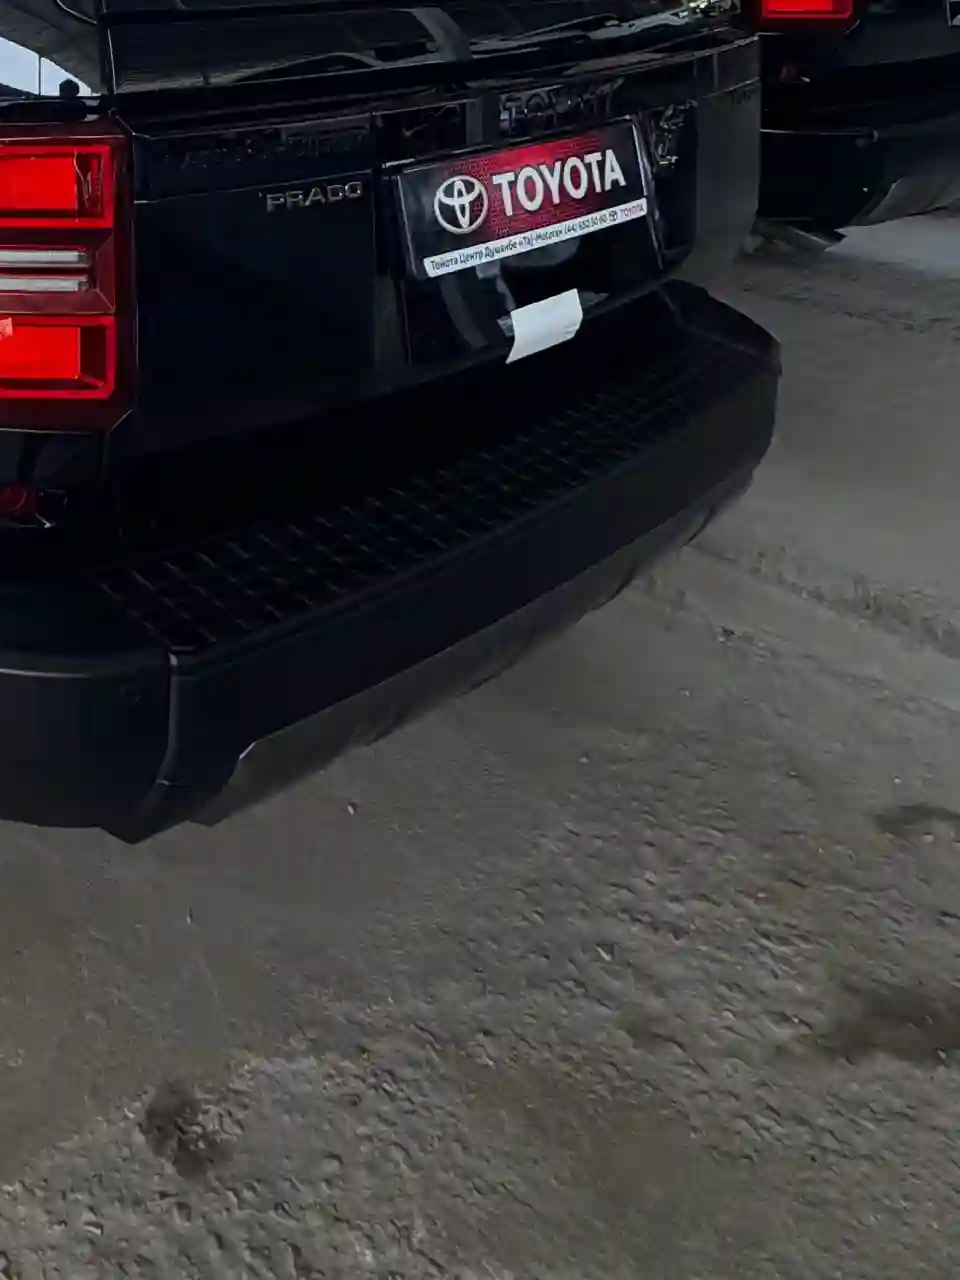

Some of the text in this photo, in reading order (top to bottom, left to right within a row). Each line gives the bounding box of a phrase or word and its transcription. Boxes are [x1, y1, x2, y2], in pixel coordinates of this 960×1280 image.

[266, 181, 362, 212] PRADO
[492, 149, 626, 218] TOYOTA
[430, 256, 459, 271] Тойота
[460, 250, 483, 265] Центр
[485, 240, 517, 257] Душанбе
[620, 204, 645, 218] TOYOTA
